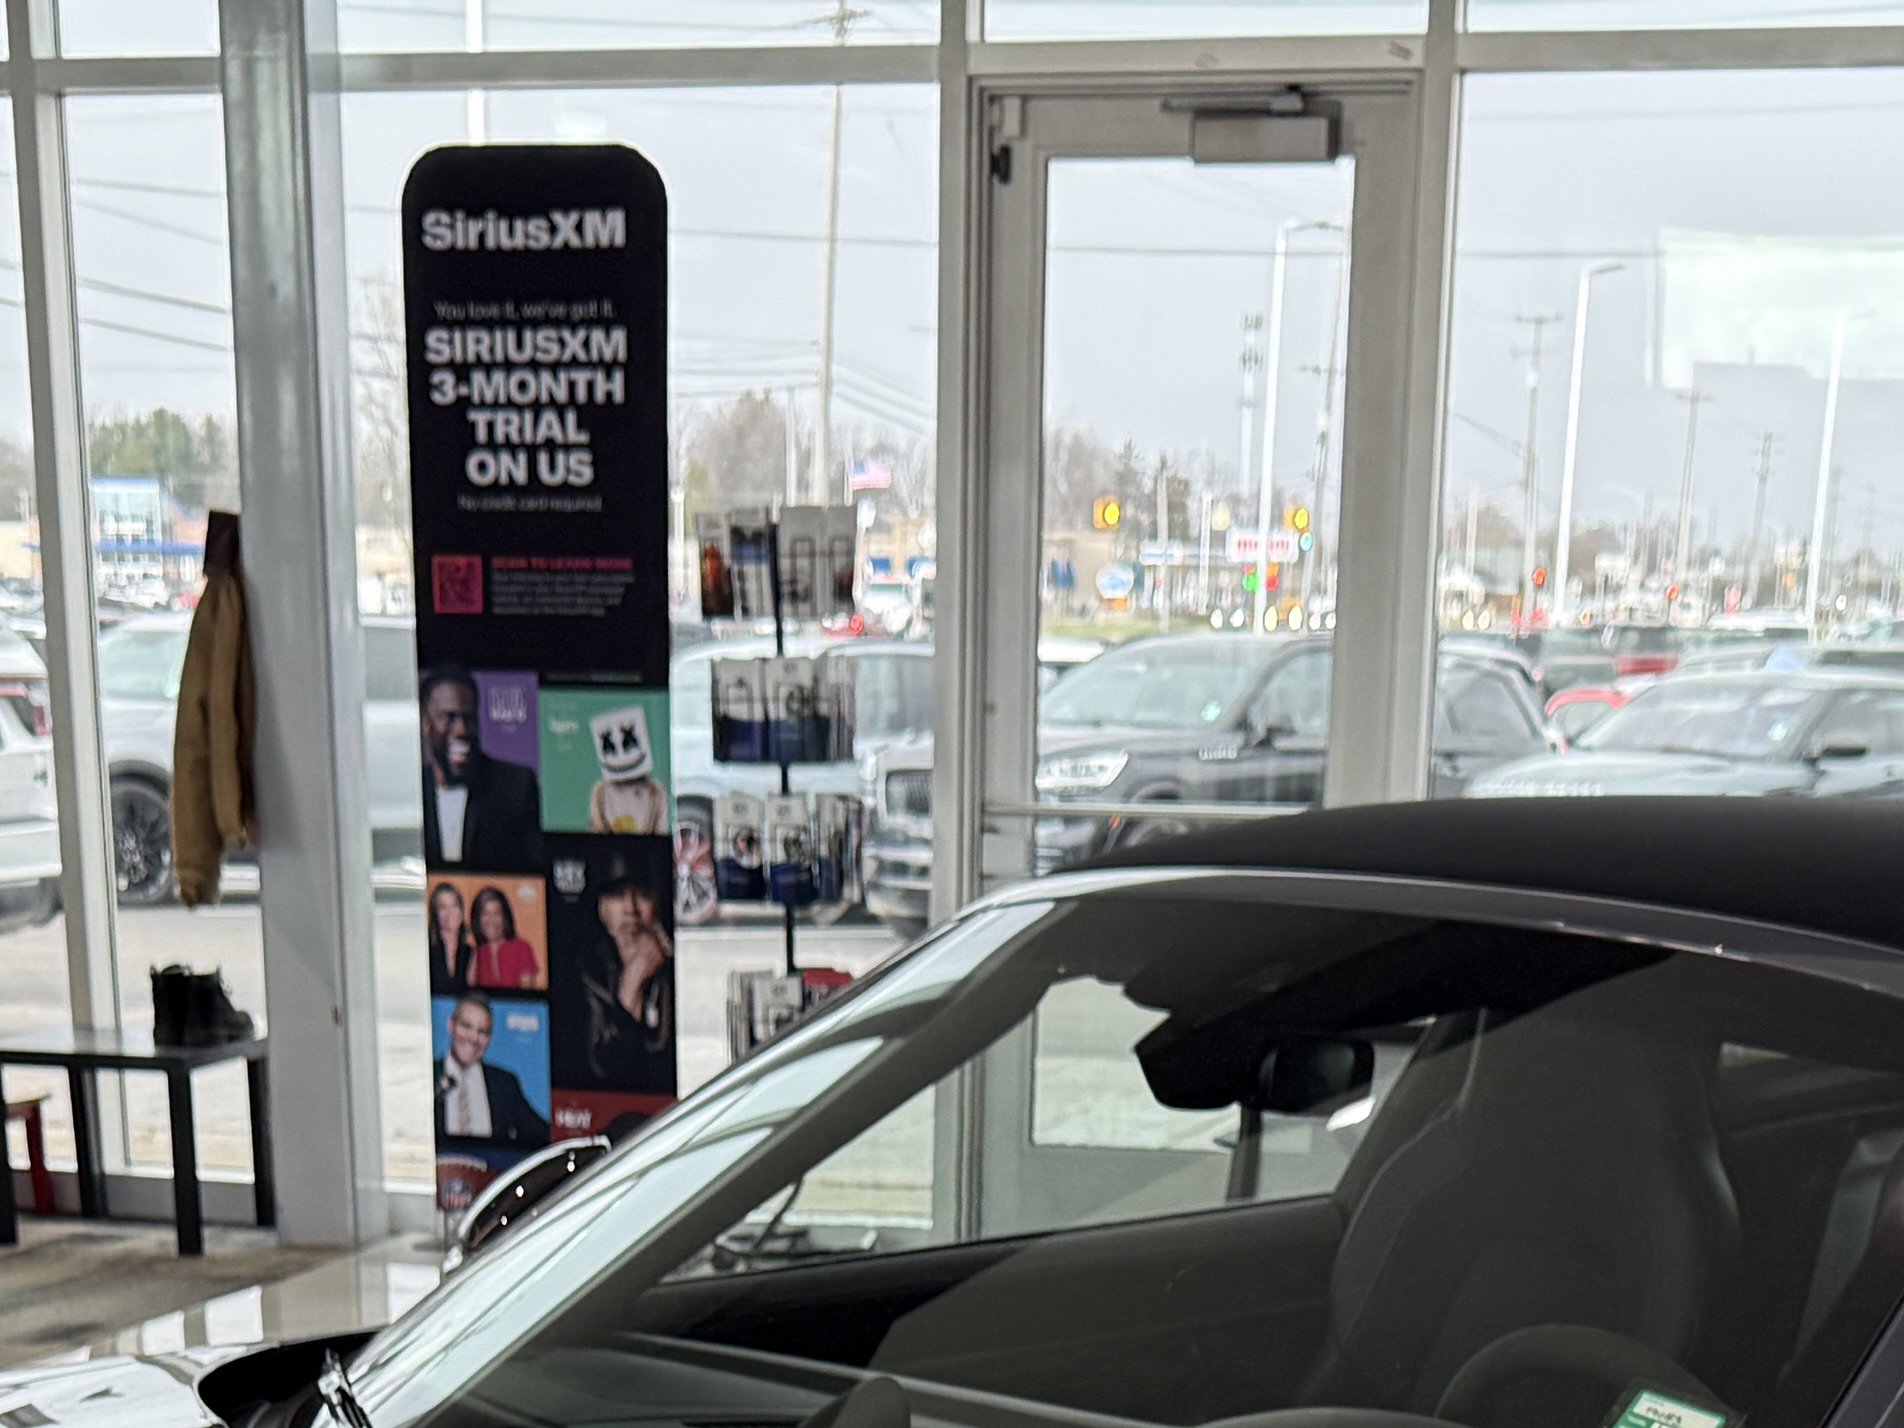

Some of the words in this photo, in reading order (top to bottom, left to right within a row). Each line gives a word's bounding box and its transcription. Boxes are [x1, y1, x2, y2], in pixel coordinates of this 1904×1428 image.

[421, 207, 627, 250] SiriusXM
[424, 325, 628, 364] SIRIUSXM
[429, 366, 625, 406] 3-MONTH
[466, 408, 591, 445] TRIAL
[465, 450, 529, 487] ON
[536, 450, 595, 487] US
